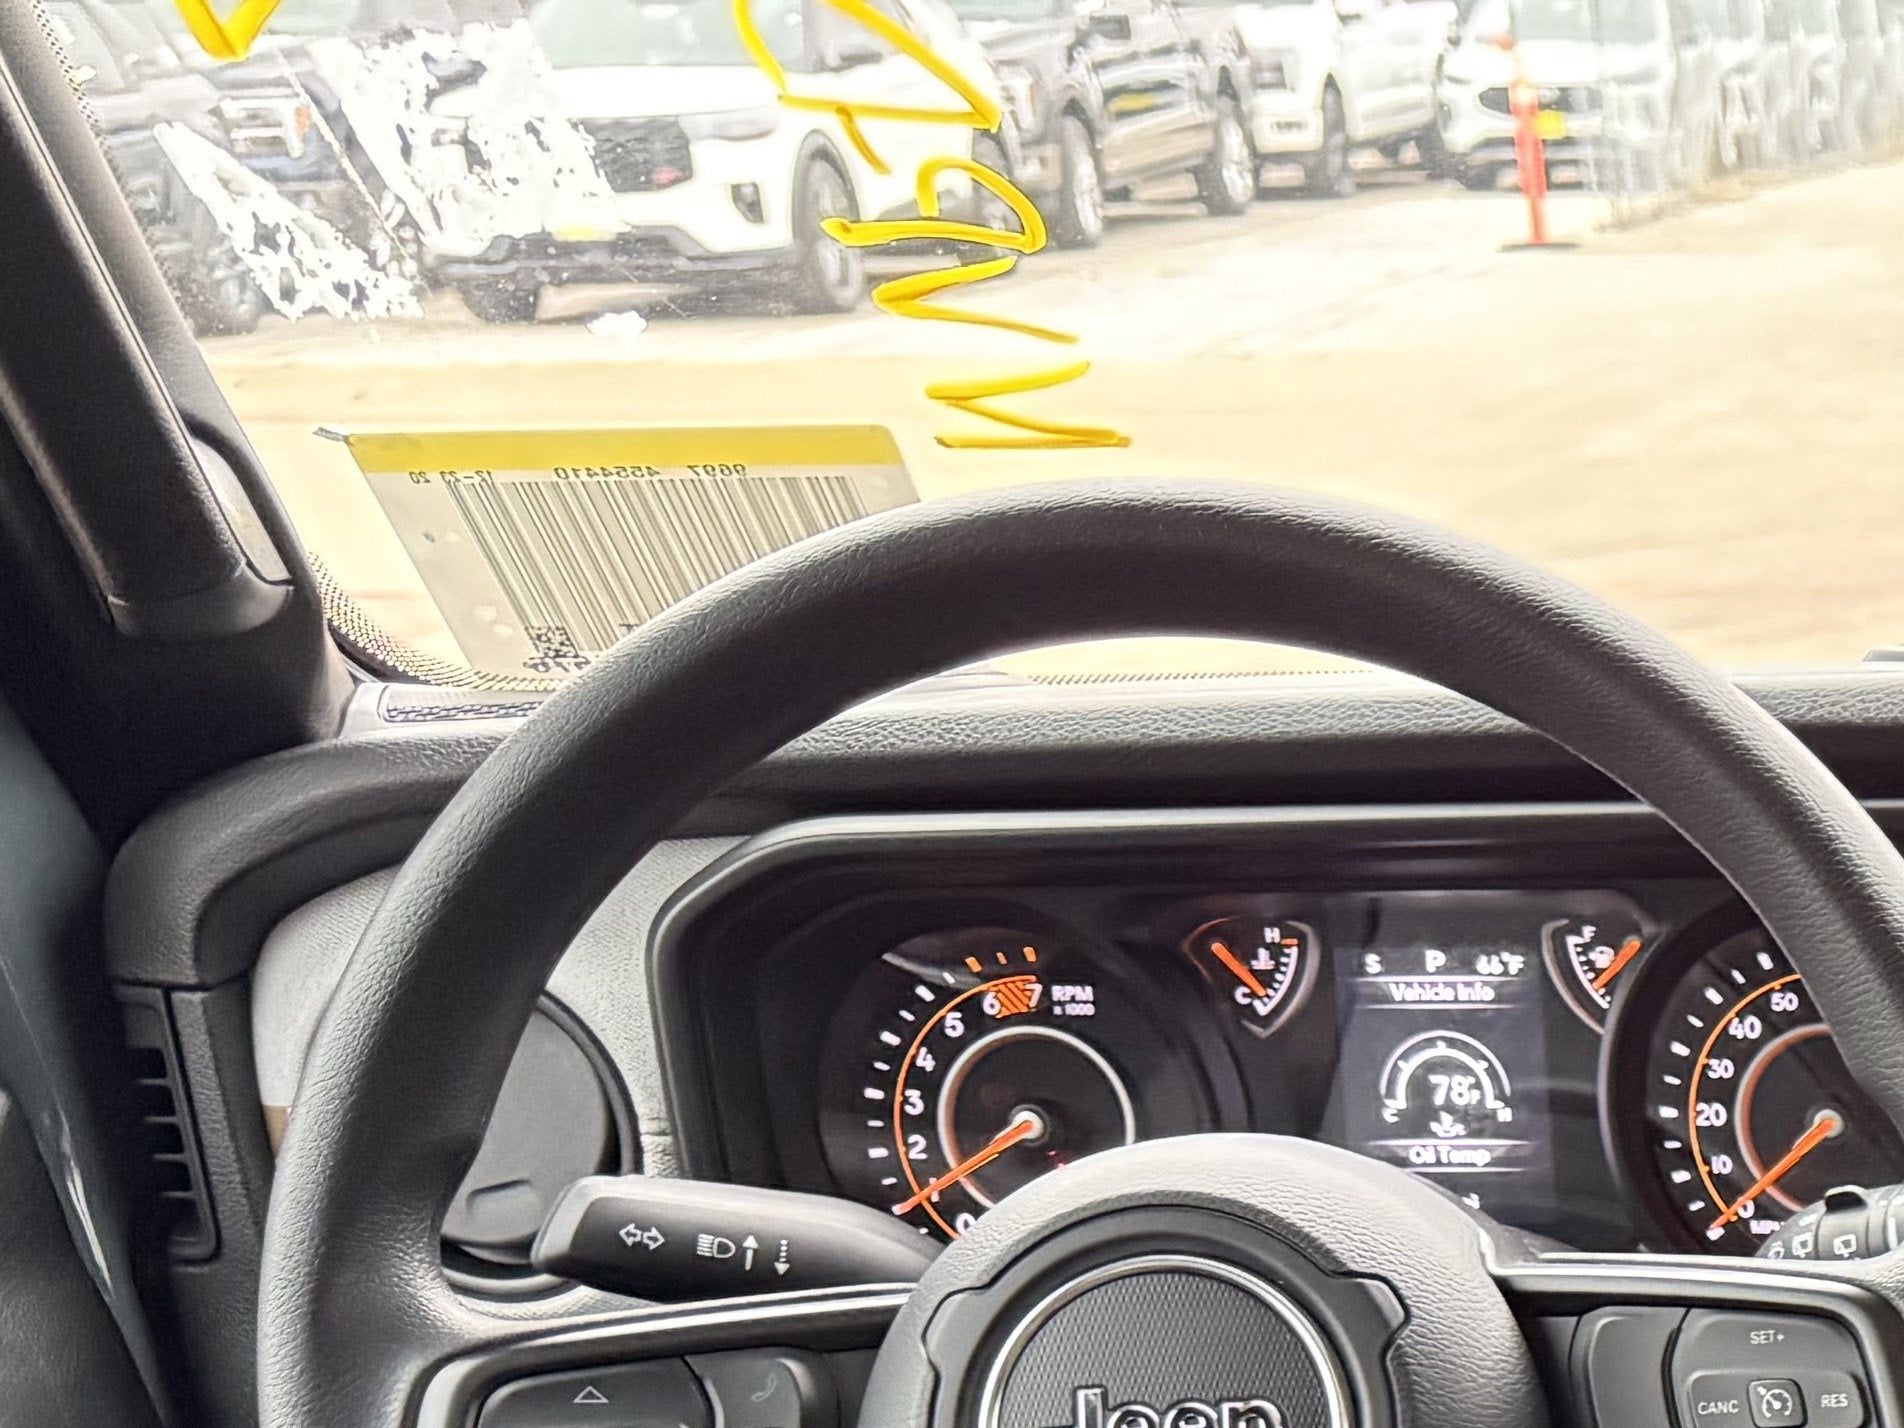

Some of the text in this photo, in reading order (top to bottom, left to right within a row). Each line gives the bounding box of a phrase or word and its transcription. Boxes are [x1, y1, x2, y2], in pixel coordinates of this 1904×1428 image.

[1424, 949, 1447, 974] P
[1023, 983, 1043, 1008] 7
[1051, 985, 1095, 1002] RPM
[1389, 981, 1496, 1002] Vehicle Info
[1770, 991, 1800, 1012] 50
[982, 992, 1001, 1016] 6
[944, 1011, 965, 1038] 5
[1728, 1014, 1762, 1040] 40
[916, 1047, 936, 1072] 4
[1707, 1057, 1735, 1080] 30
[904, 1089, 924, 1115] 3
[1695, 1102, 1728, 1128] 20
[907, 1134, 928, 1160] 2
[1710, 1154, 1733, 1175] 10
[1697, 1399, 1740, 1416] CANC
[1820, 1393, 1849, 1408] RES
